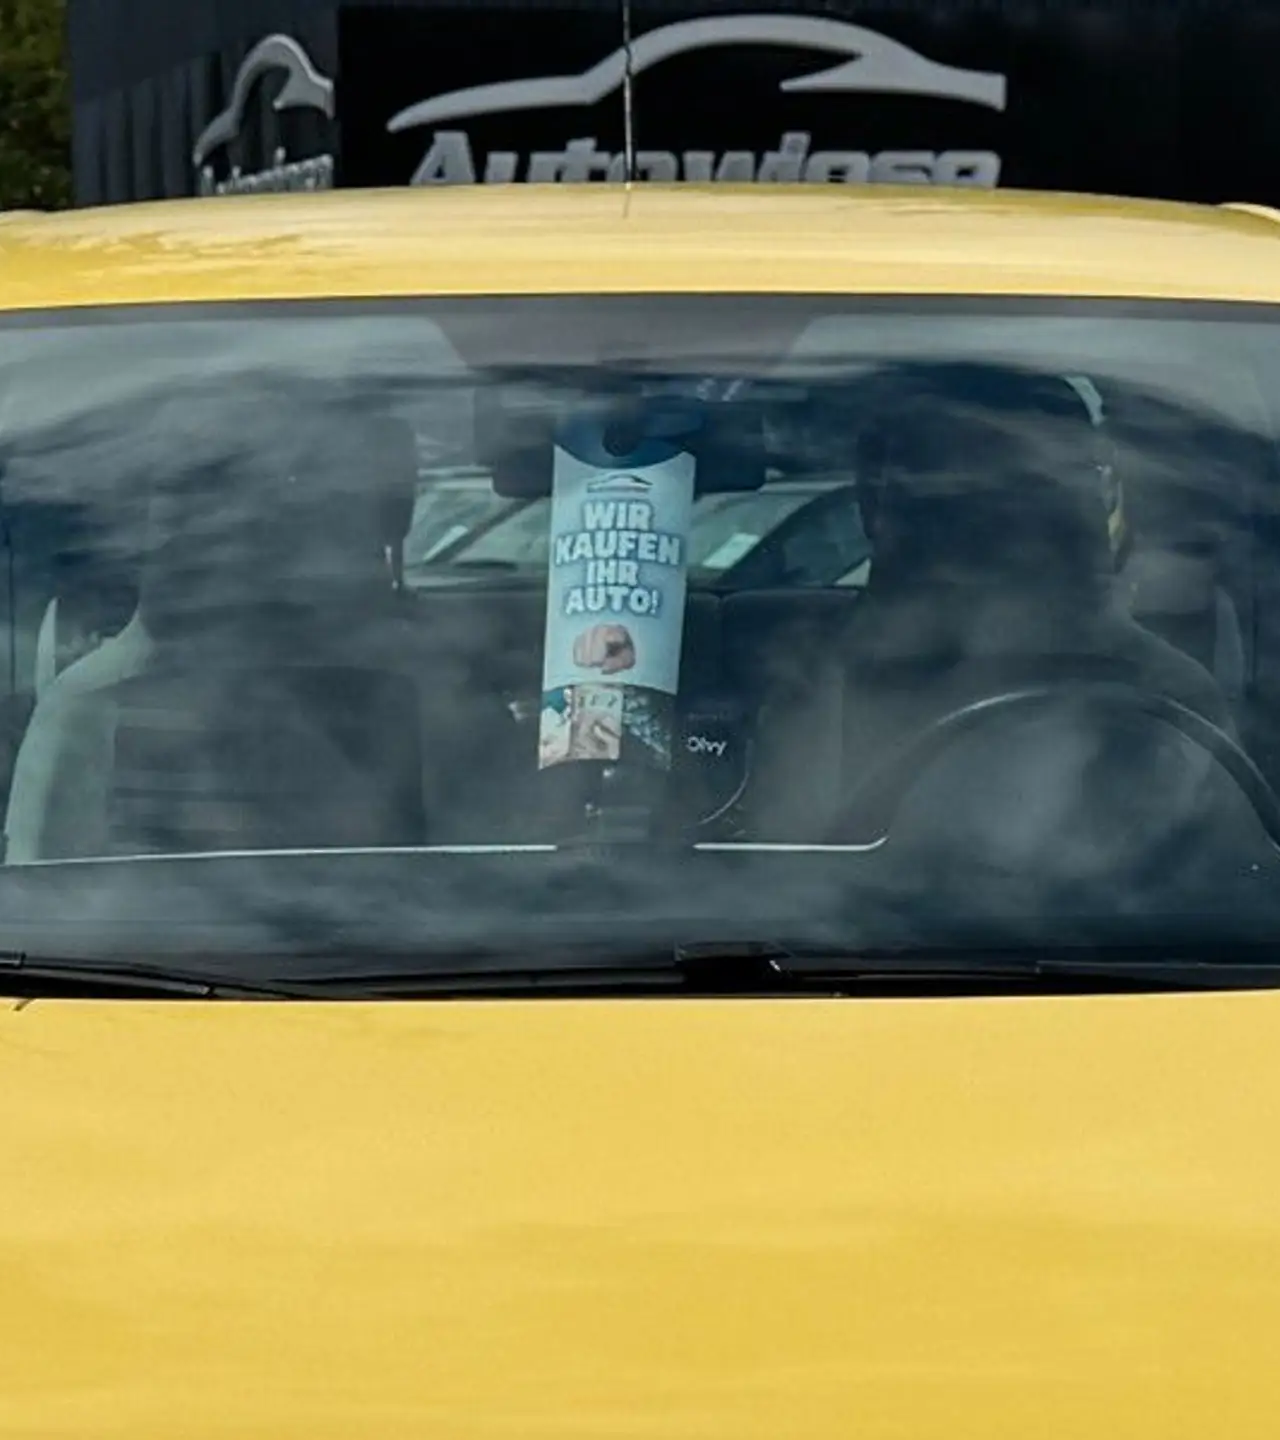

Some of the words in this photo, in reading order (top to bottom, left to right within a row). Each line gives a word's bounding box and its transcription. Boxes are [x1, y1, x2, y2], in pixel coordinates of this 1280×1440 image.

[583, 501, 651, 530] WIR
[555, 529, 680, 566] KAUFEN
[586, 558, 639, 586] IHR
[565, 584, 659, 615] AUTO!
